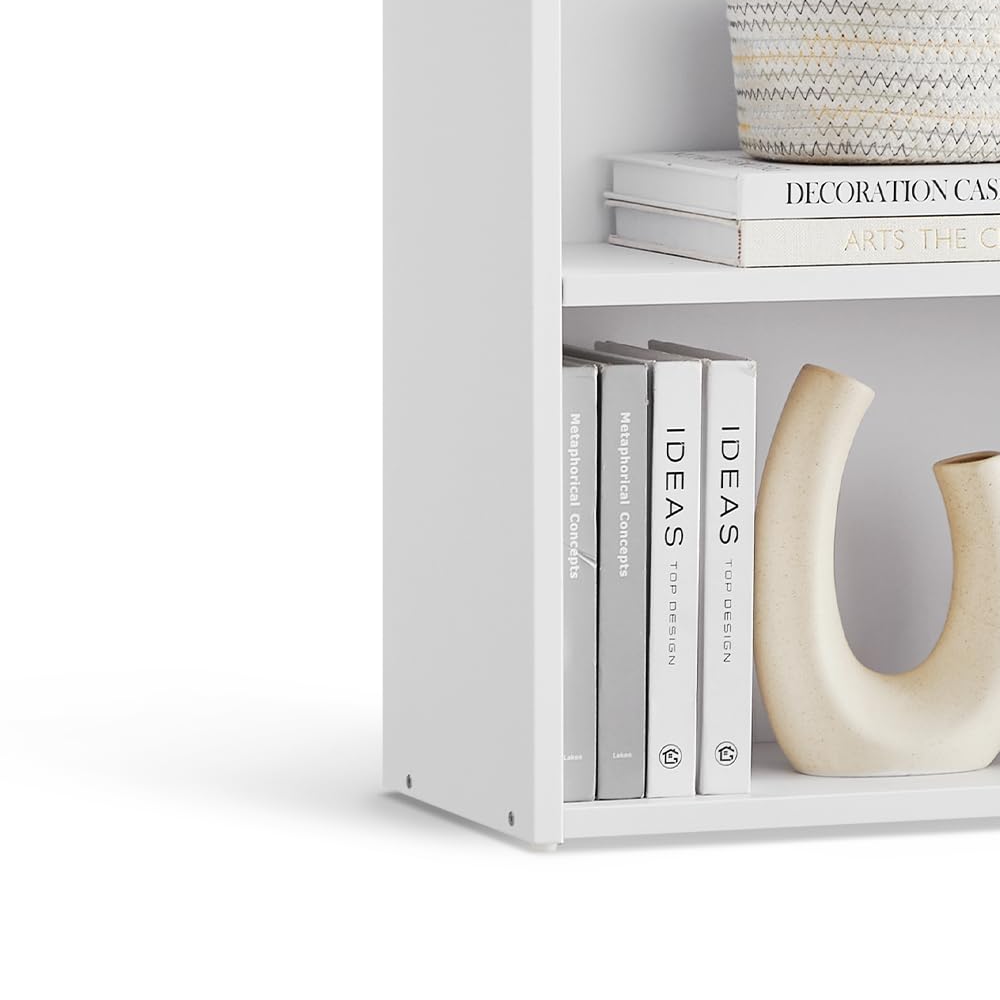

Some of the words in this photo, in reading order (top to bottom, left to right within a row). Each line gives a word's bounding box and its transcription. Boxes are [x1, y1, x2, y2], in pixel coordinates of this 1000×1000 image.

[785, 179, 949, 205] DECORATION
[844, 229, 905, 252] ARTS
[919, 228, 968, 250] THE
[568, 412, 582, 506] Metaphorical
[617, 411, 632, 505] Metaphorical
[664, 428, 685, 547] IDEAS
[719, 426, 740, 545] IDEAS
[568, 512, 582, 579] Concepts
[617, 510, 631, 578] Concepts
[723, 559, 733, 593] TOP
[668, 560, 678, 595] TOP
[668, 601, 677, 667] DESIGN
[722, 598, 732, 664] DESIGN
